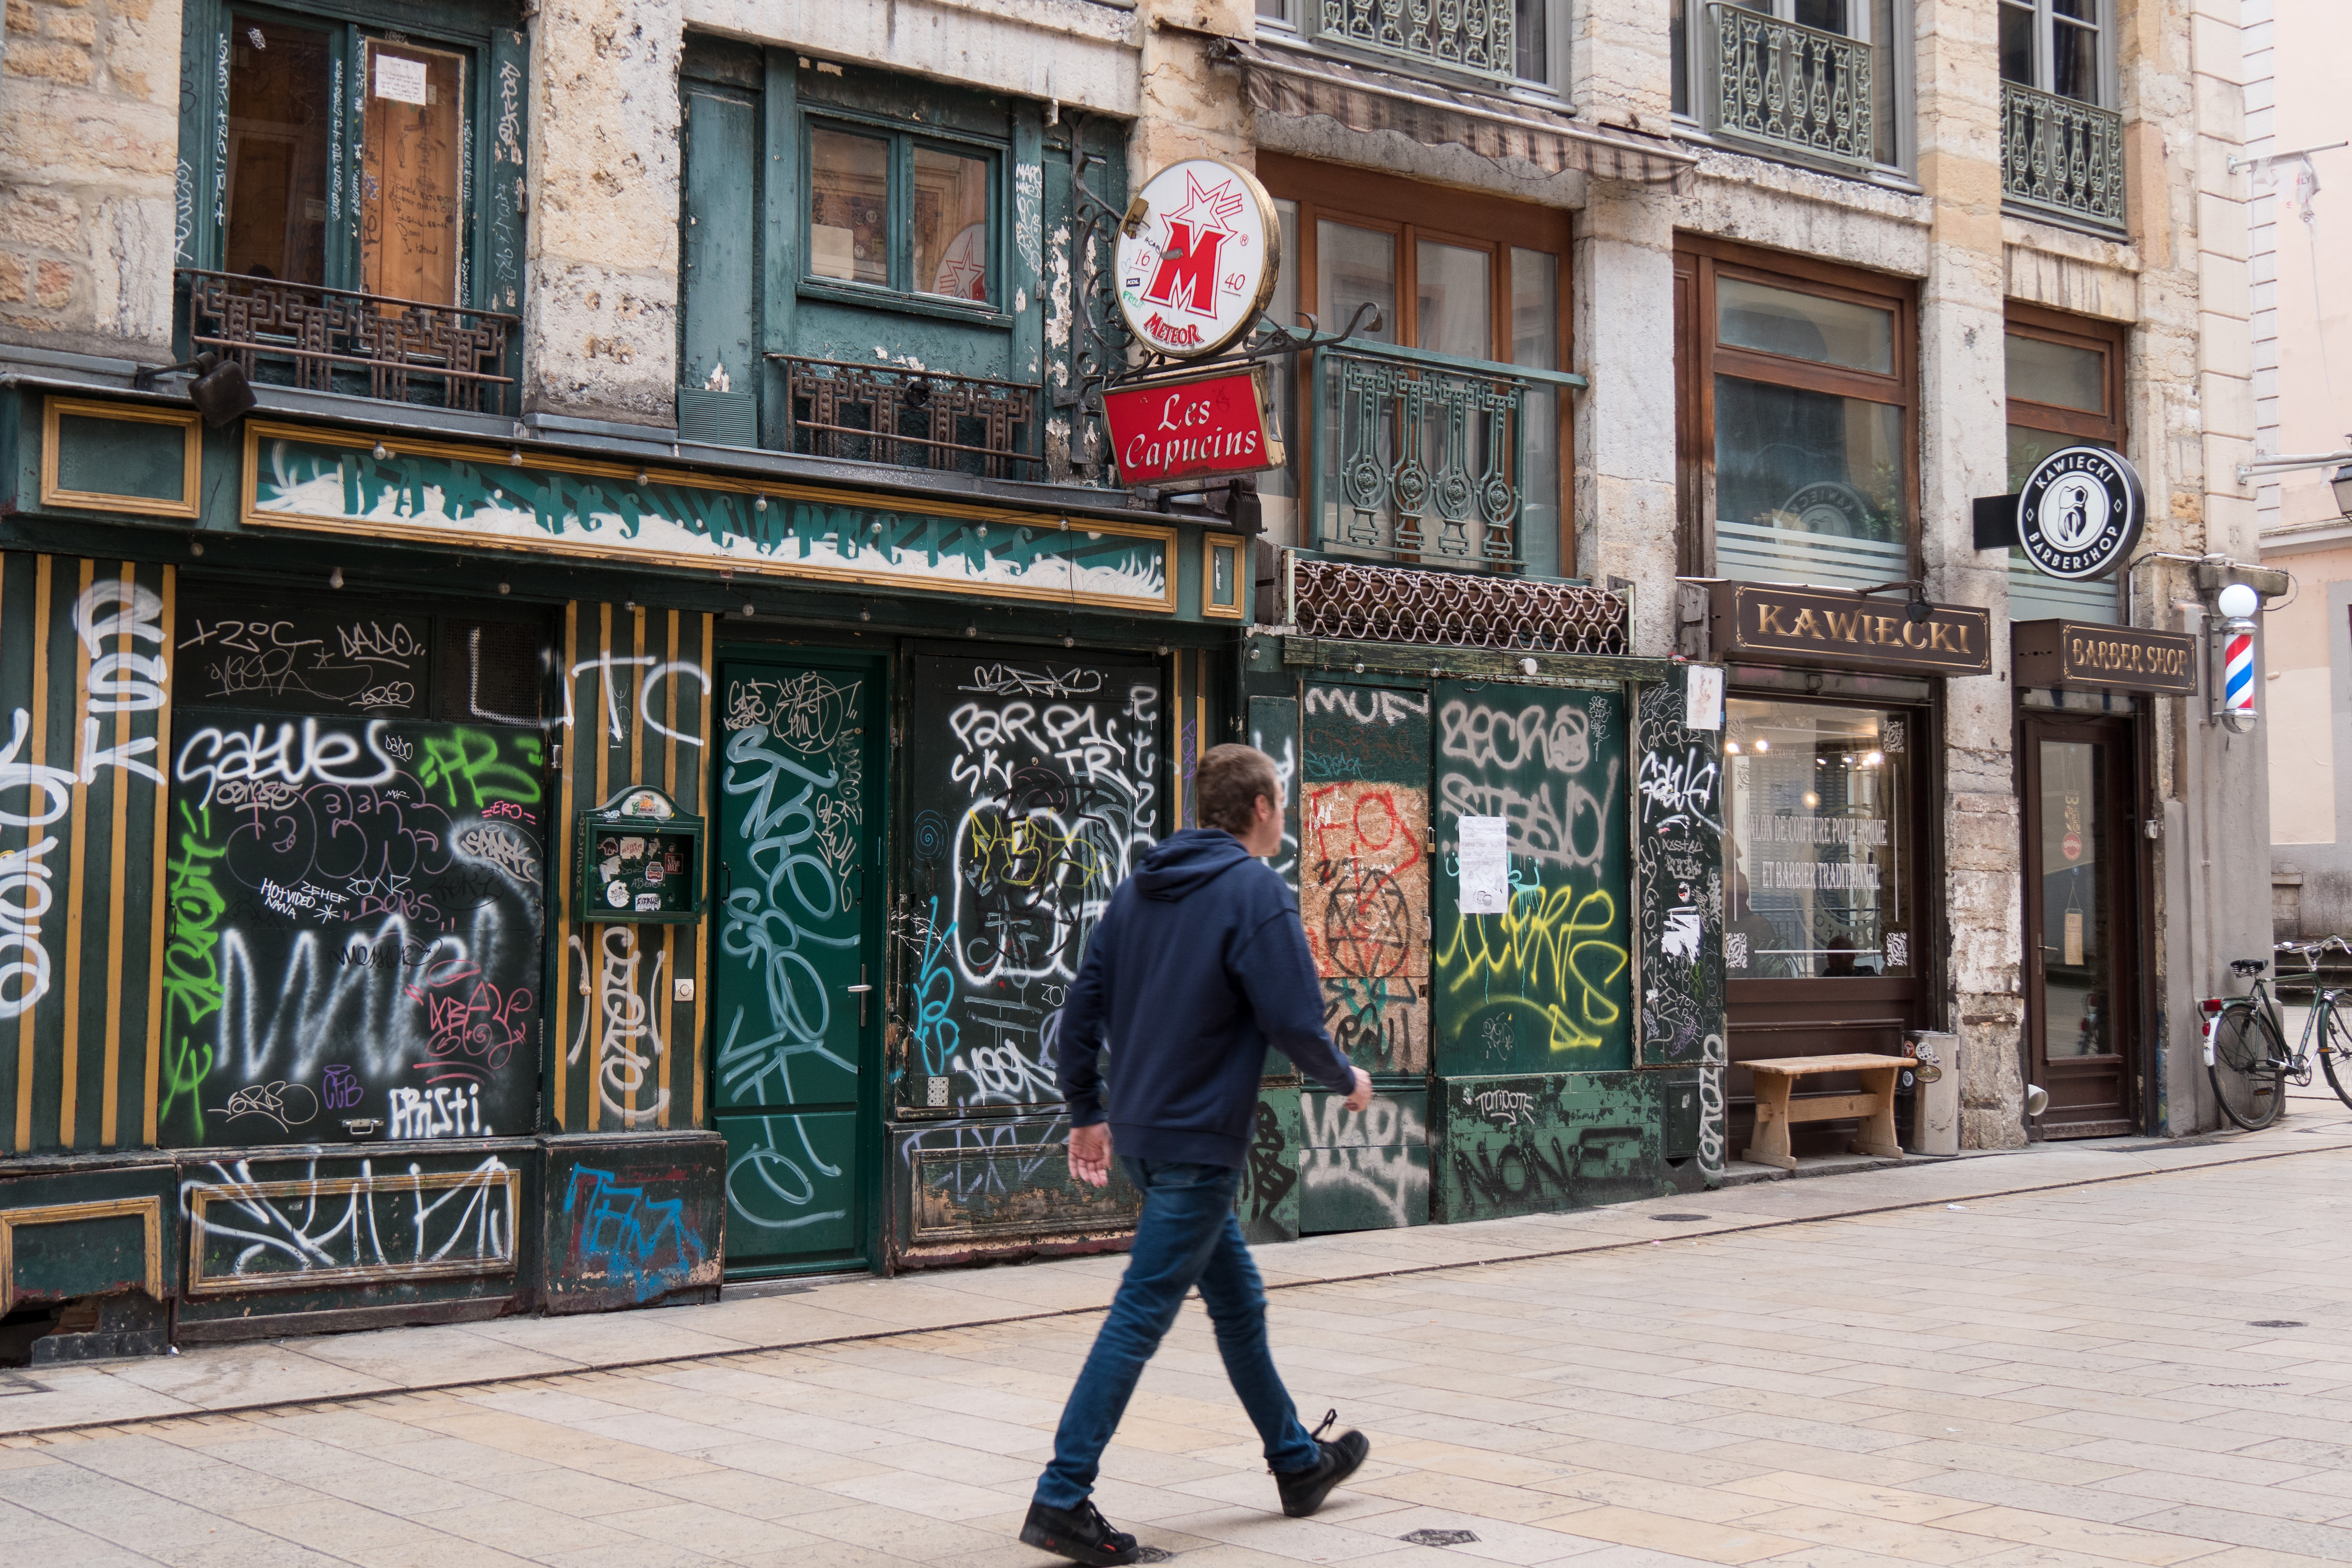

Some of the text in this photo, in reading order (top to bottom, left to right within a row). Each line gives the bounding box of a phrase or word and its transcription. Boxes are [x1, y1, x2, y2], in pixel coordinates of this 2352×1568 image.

[1135, 249, 1151, 267] 16
[1225, 272, 1245, 291] 40
[1144, 312, 1204, 346] METEOR
[1158, 393, 1211, 431] Les
[1125, 426, 1257, 472] Capucins
[2035, 456, 2114, 489] KAWIECKI
[2028, 526, 2118, 569] BARBERSHOP
[1757, 603, 1971, 654] KAWIECKI
[2072, 638, 2188, 676] BARBER SHOP
[1749, 815, 1888, 845] ALON DE COIFFURE POUR HOMME
[1762, 861, 1881, 890] ET BARBIER TRADITIONNEL
